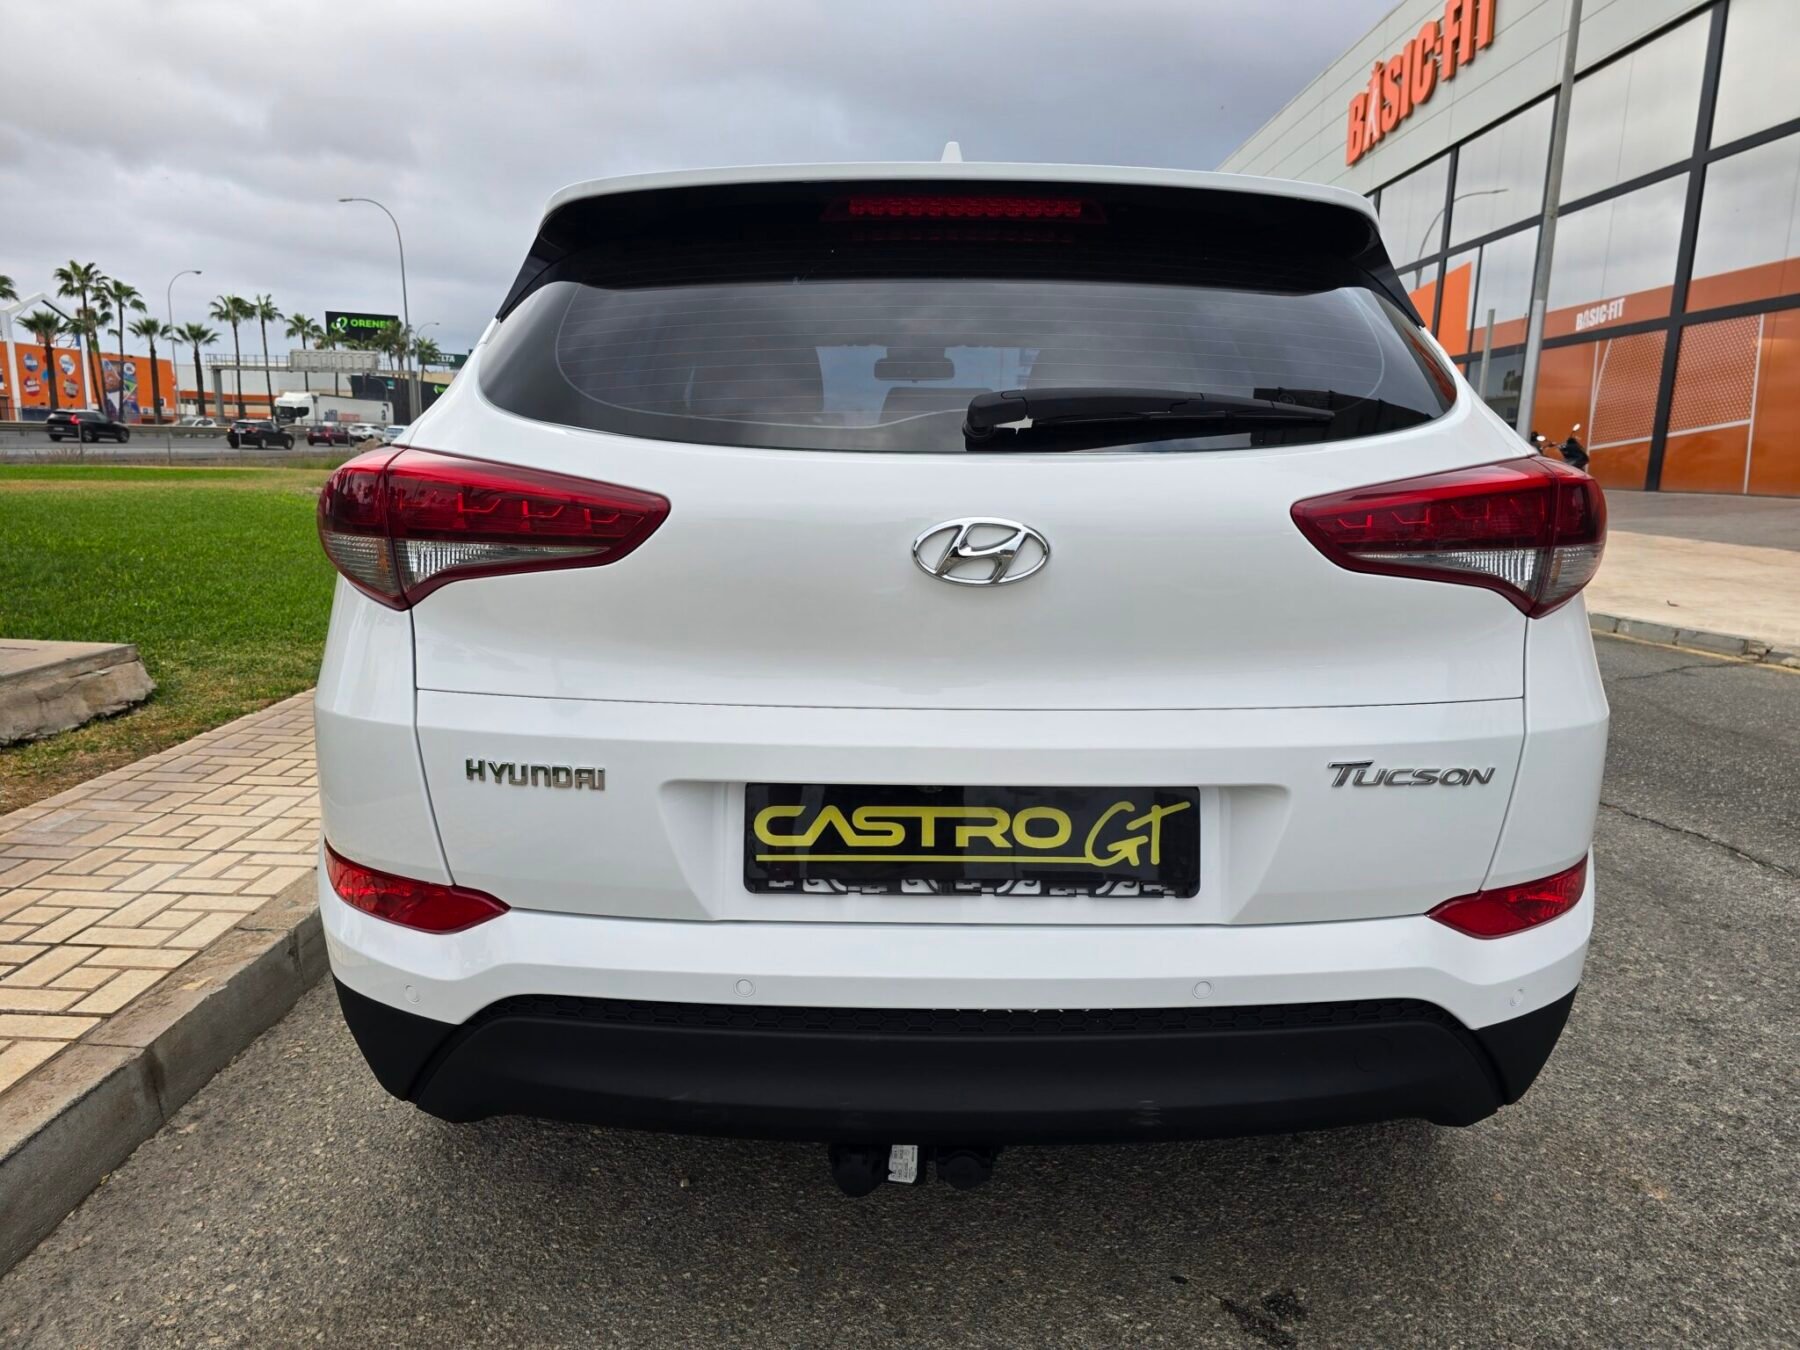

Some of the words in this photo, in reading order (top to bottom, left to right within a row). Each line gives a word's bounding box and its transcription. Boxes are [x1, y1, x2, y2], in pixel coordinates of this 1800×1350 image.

[1575, 298, 1626, 331] BASIC-FIT
[465, 758, 606, 791] HYUNDAI
[1328, 759, 1496, 787] TUCSON
[753, 804, 1073, 849] CASTRO
[1084, 801, 1191, 867] GT
